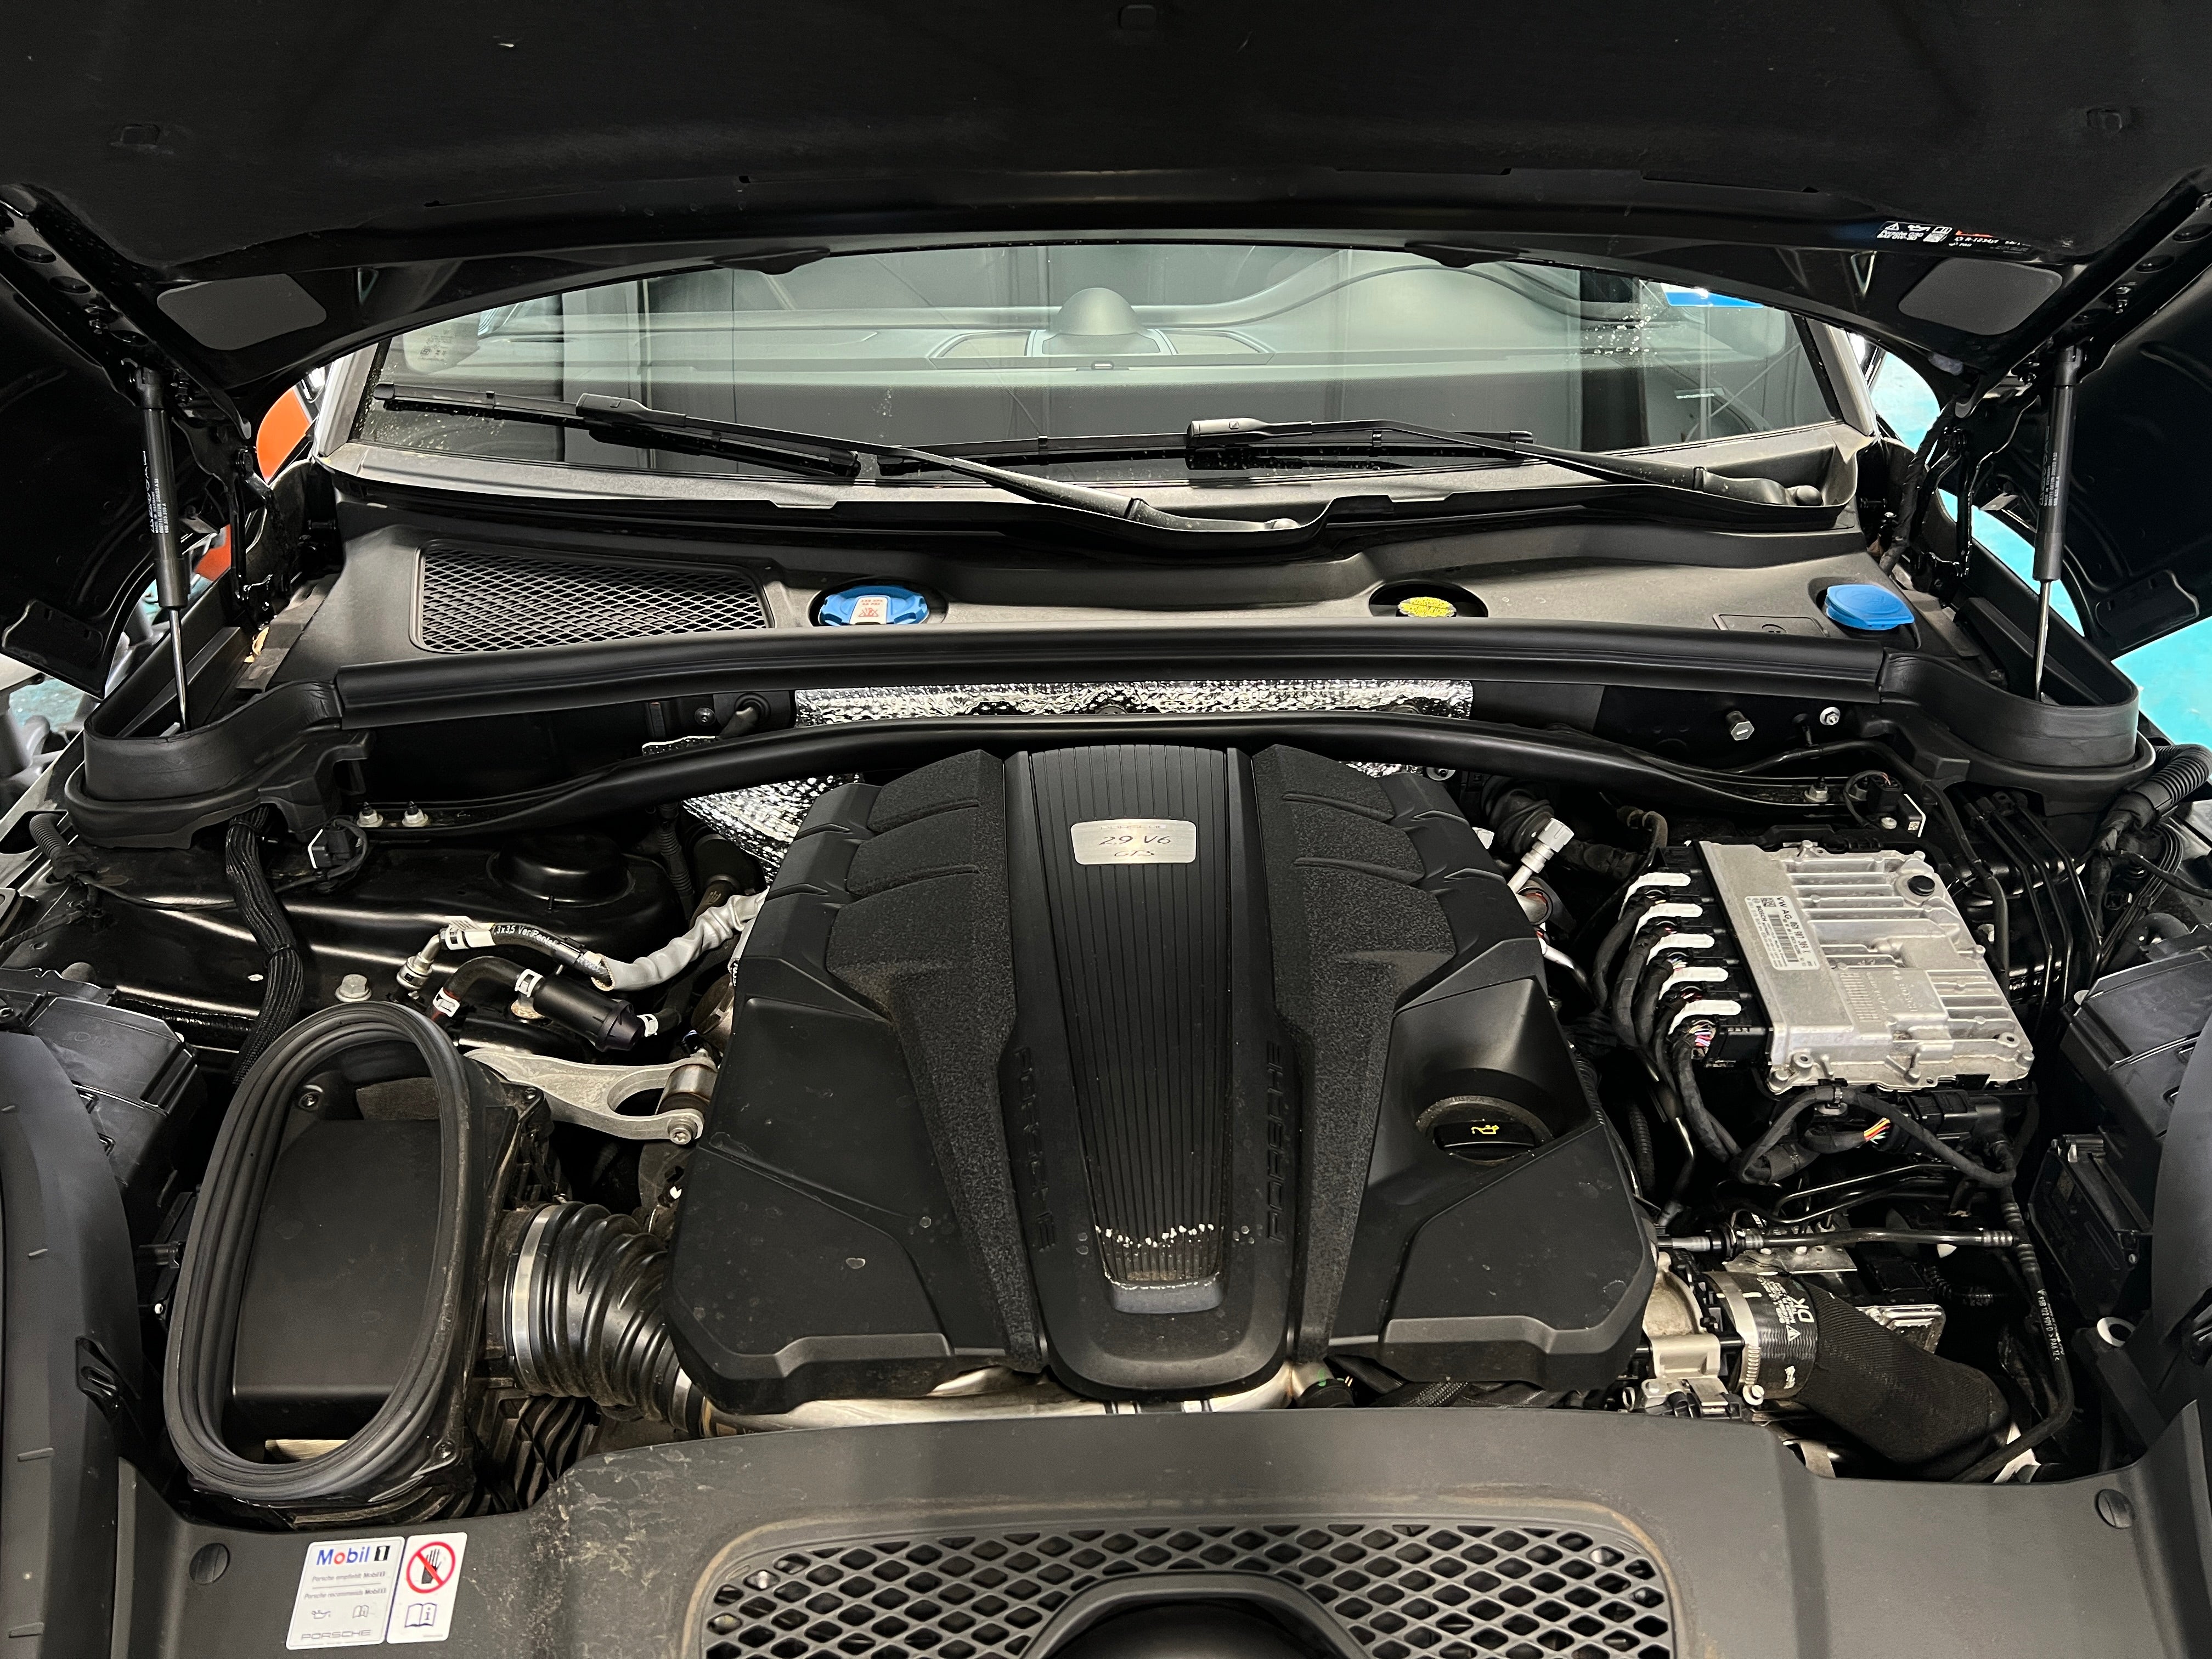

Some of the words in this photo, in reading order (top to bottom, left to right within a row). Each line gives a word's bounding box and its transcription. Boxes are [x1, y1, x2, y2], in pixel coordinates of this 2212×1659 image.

[1098, 835, 1133, 846] 2.9
[1143, 834, 1172, 845] V6
[1756, 905, 1768, 922] BOSCH
[1782, 909, 1792, 919] AG
[1266, 1041, 1285, 1243] PORSCHE
[316, 1546, 370, 1566] Mobil
[376, 1545, 389, 1562] 1
[301, 1629, 371, 1640] PORSCHE
